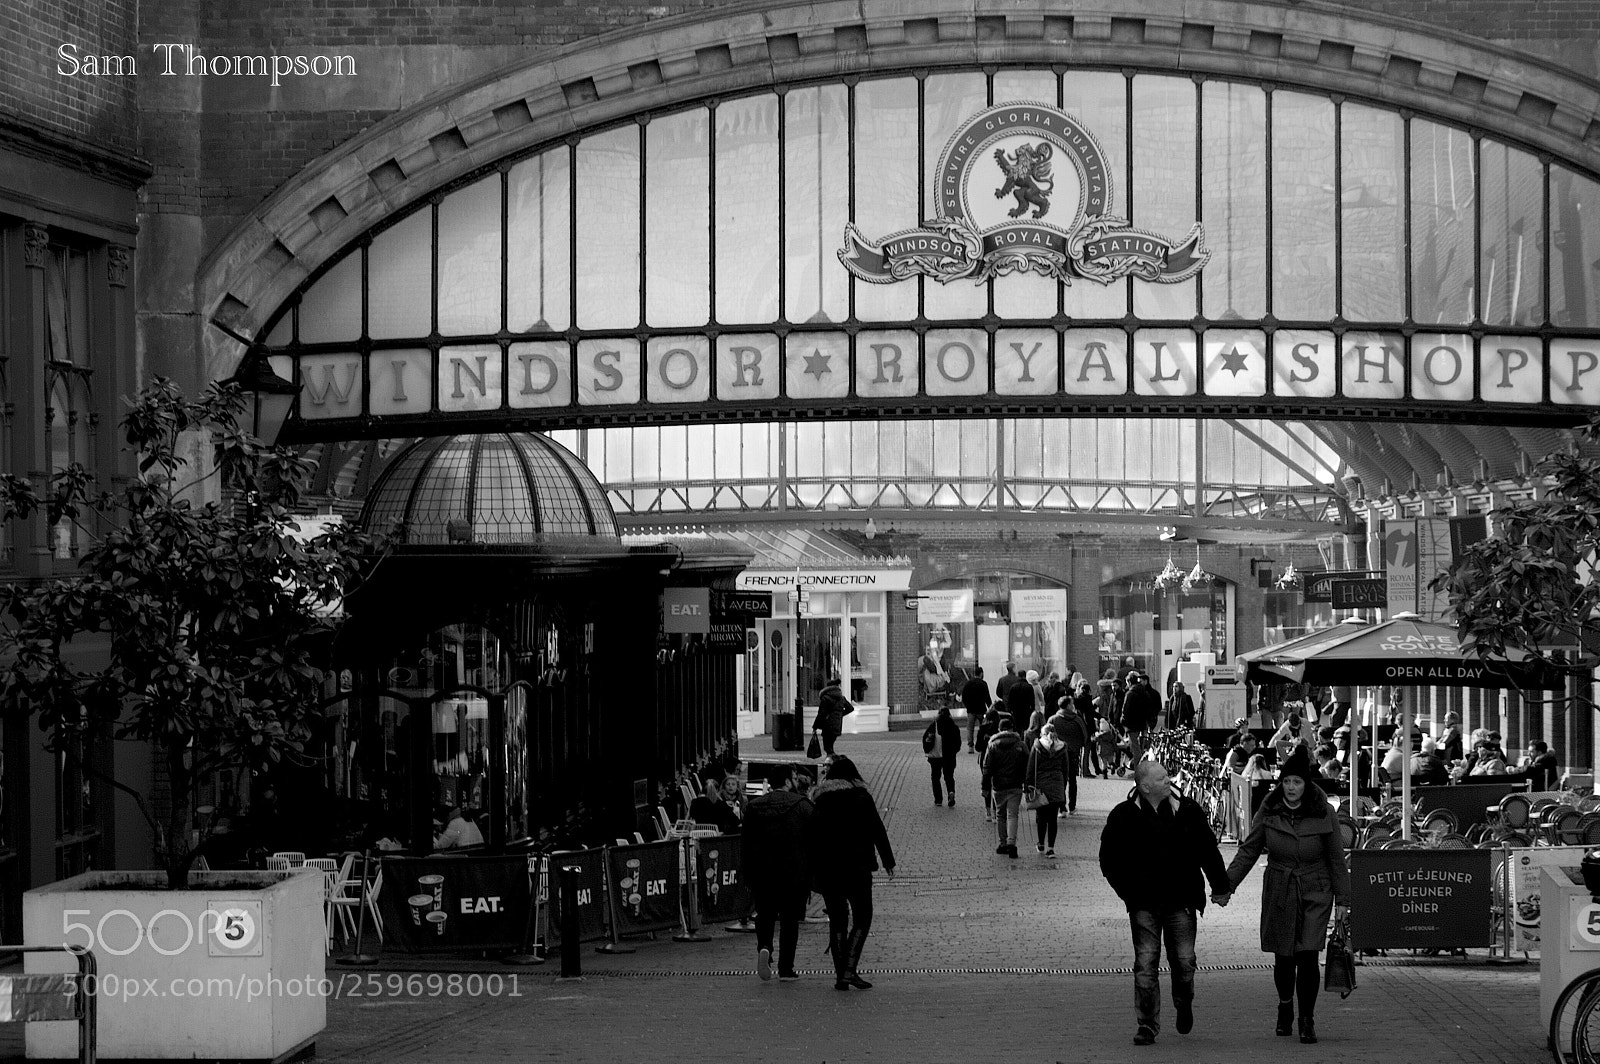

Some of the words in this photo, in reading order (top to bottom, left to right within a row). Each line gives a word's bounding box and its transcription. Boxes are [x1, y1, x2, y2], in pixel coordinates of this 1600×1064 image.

[946, 135, 976, 207] SERVIRE
[985, 112, 1052, 130] GLORIA
[1063, 125, 1101, 207] QUALITAS
[886, 239, 965, 258] WINDSOR
[994, 233, 1054, 247] ROYAL
[1088, 239, 1166, 258] STATION
[300, 346, 763, 405] WINDSOR
[869, 342, 1181, 384] ROYAL
[1290, 342, 1599, 391] SHOPP
[744, 576, 795, 585] FRENCH
[798, 575, 876, 585] CONNECTION
[671, 604, 702, 616] EAT.
[729, 601, 768, 610] AVEDA
[711, 624, 743, 632] MOLTON
[711, 633, 743, 641] BROWN
[1380, 643, 1462, 651] ROUG
[1386, 666, 1424, 678] OPEN
[1429, 666, 1452, 678] ALL
[1457, 667, 1483, 679] DAY
[1369, 871, 1404, 885] PETIT
[646, 879, 668, 896] EAT.
[1389, 884, 1452, 897] DÉJEUNER
[460, 896, 504, 914] EAT.
[1402, 900, 1438, 913] DÎNER
[225, 915, 246, 941] 5
[1587, 911, 1600, 936] 5
